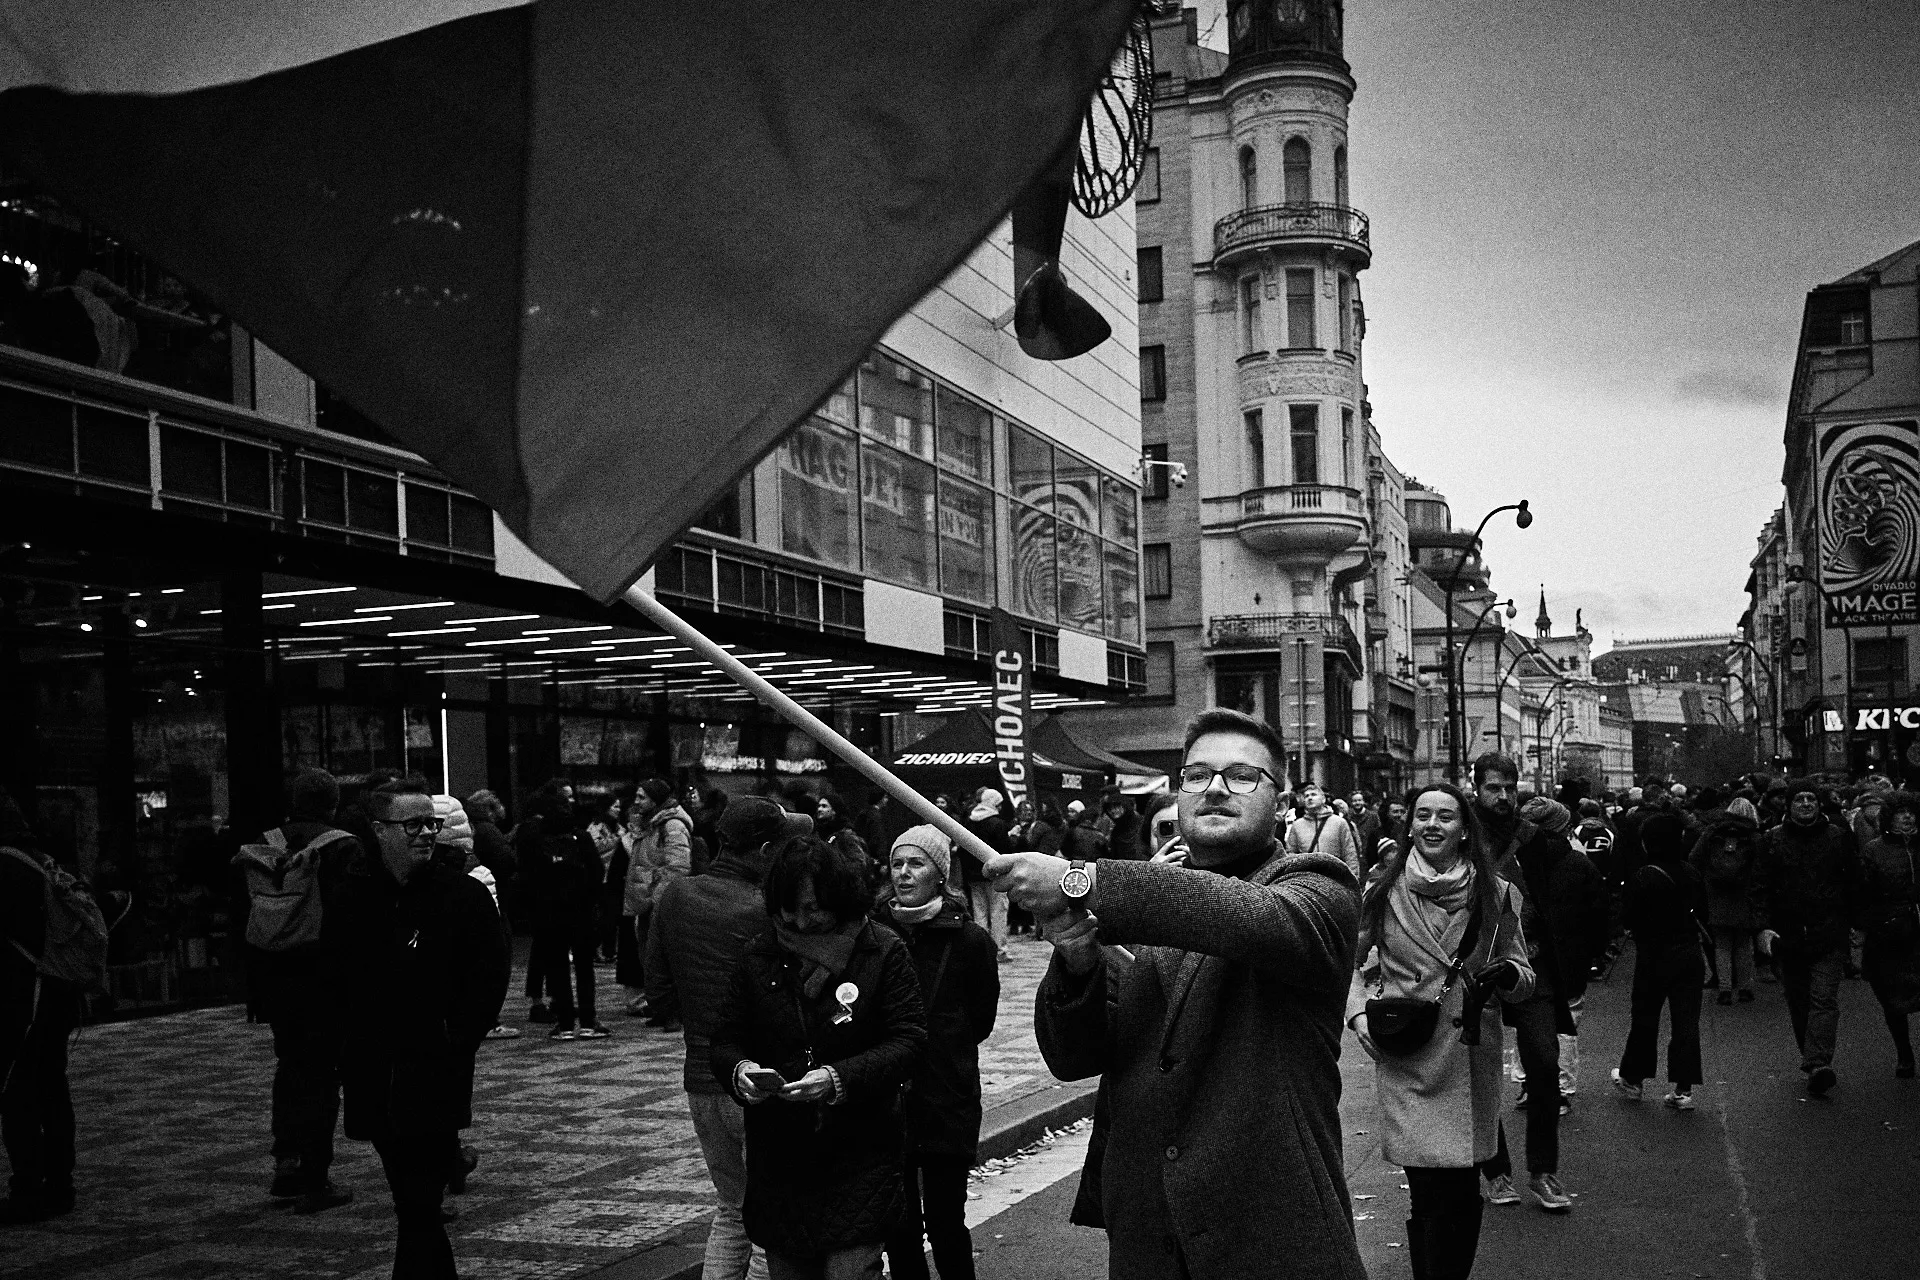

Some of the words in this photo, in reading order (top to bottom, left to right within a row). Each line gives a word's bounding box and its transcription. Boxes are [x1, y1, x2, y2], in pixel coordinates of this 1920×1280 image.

[1873, 580, 1917, 592] DIVADLO
[1832, 592, 1917, 613] IMAGE
[1832, 614, 1868, 624] BACK
[1855, 706, 1920, 731] KFC
[893, 752, 997, 765] ZICHOVEC
